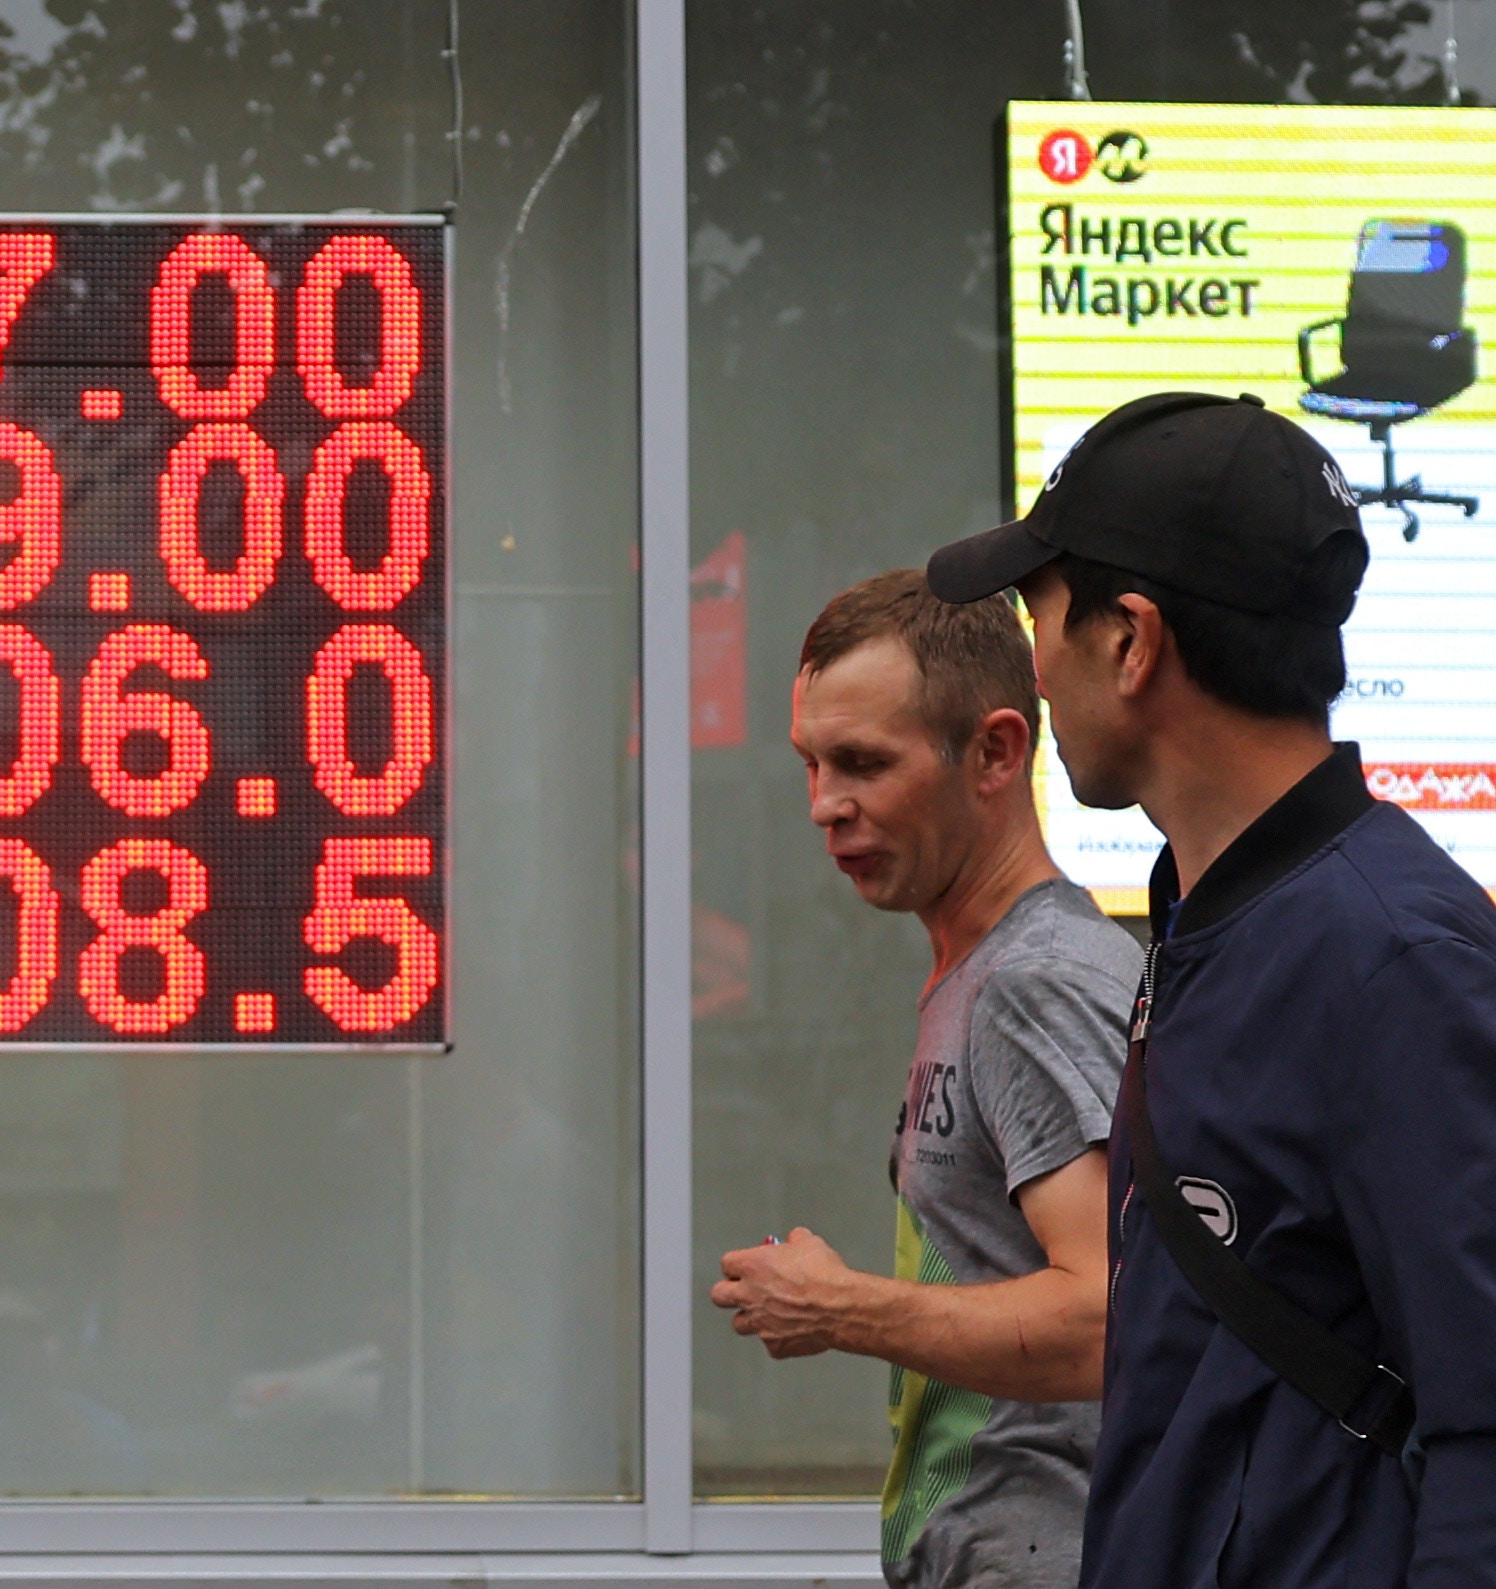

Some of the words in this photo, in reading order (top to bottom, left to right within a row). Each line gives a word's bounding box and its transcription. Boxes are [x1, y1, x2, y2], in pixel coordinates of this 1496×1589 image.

[1039, 204, 1249, 263] Яндекс
[1039, 265, 1262, 326] Маркет
[1340, 678, 1405, 697] есло
